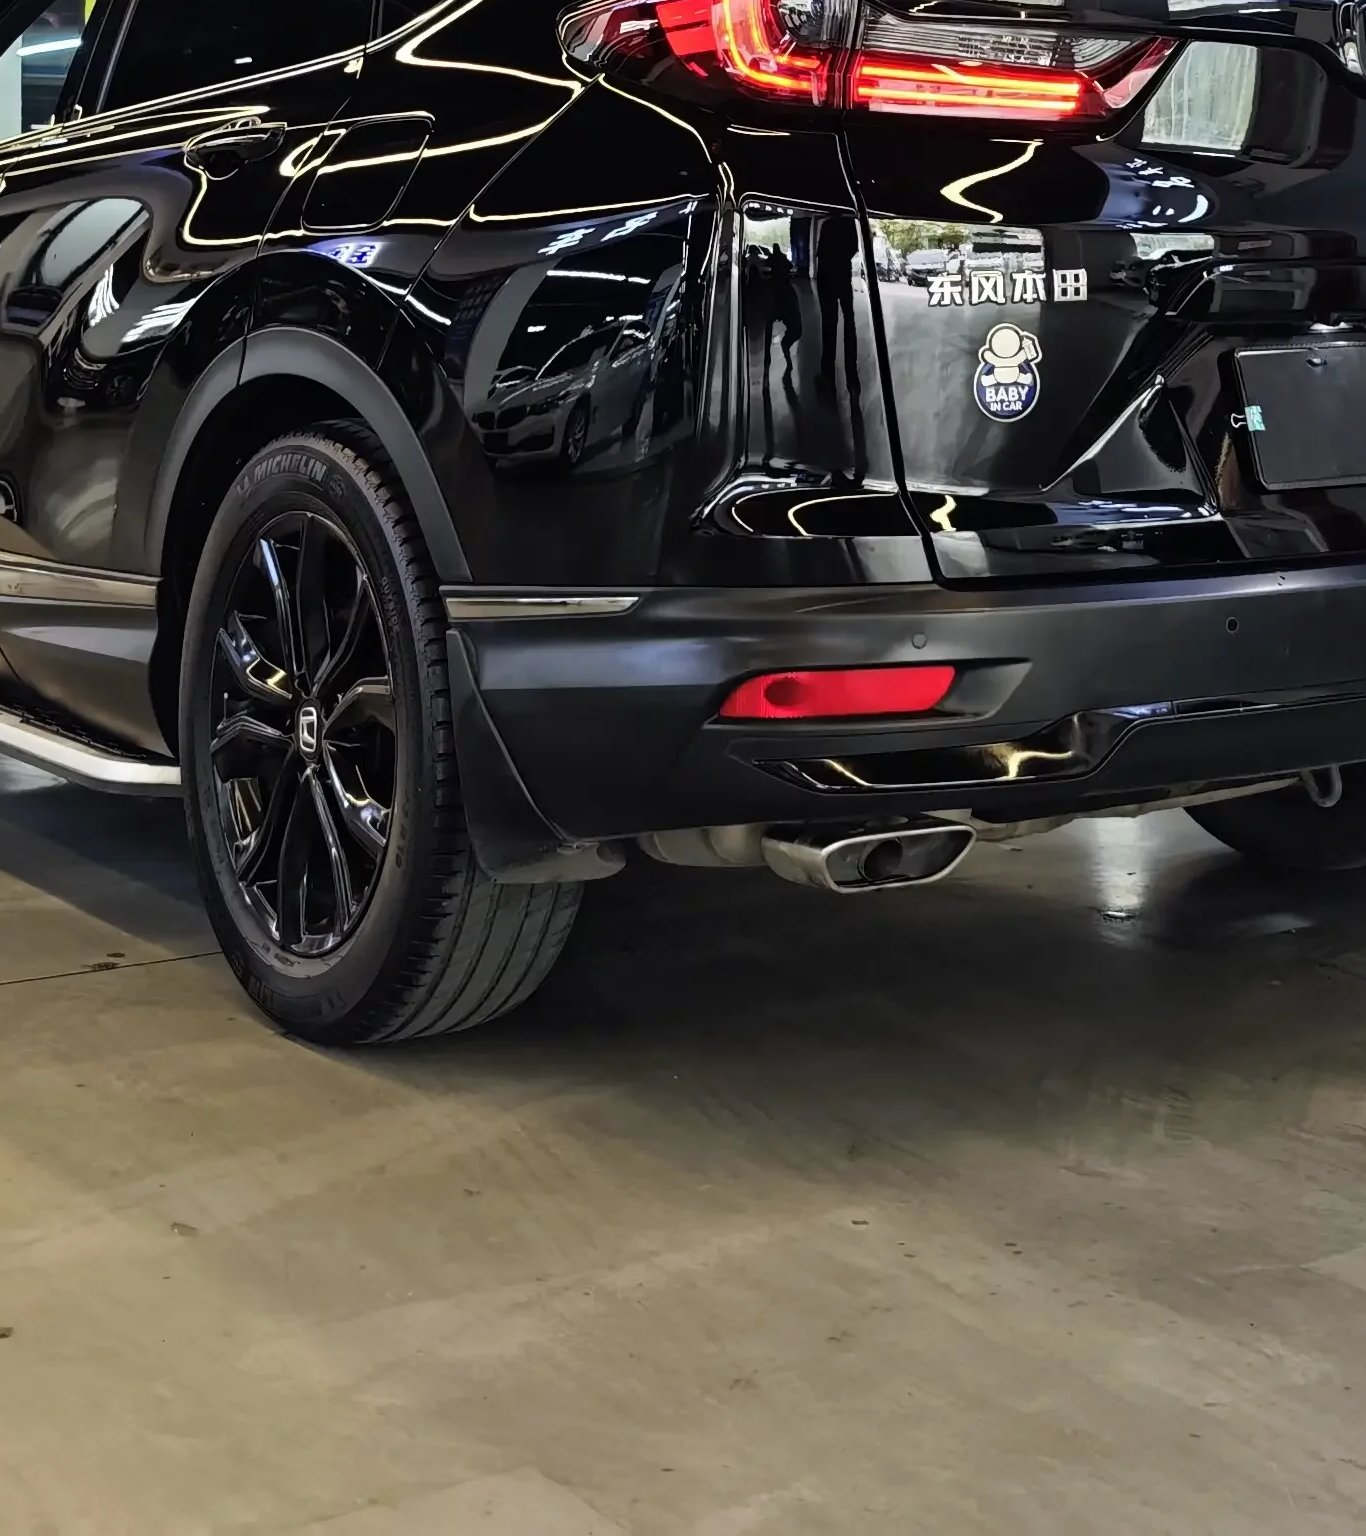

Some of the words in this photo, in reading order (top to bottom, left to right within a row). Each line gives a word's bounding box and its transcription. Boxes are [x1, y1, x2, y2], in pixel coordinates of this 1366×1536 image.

[927, 268, 1088, 306] 东风本田
[985, 386, 1029, 402] BABY
[990, 402, 1001, 412] IN
[1002, 401, 1023, 411] CAR
[254, 453, 327, 483] MICHELIN
